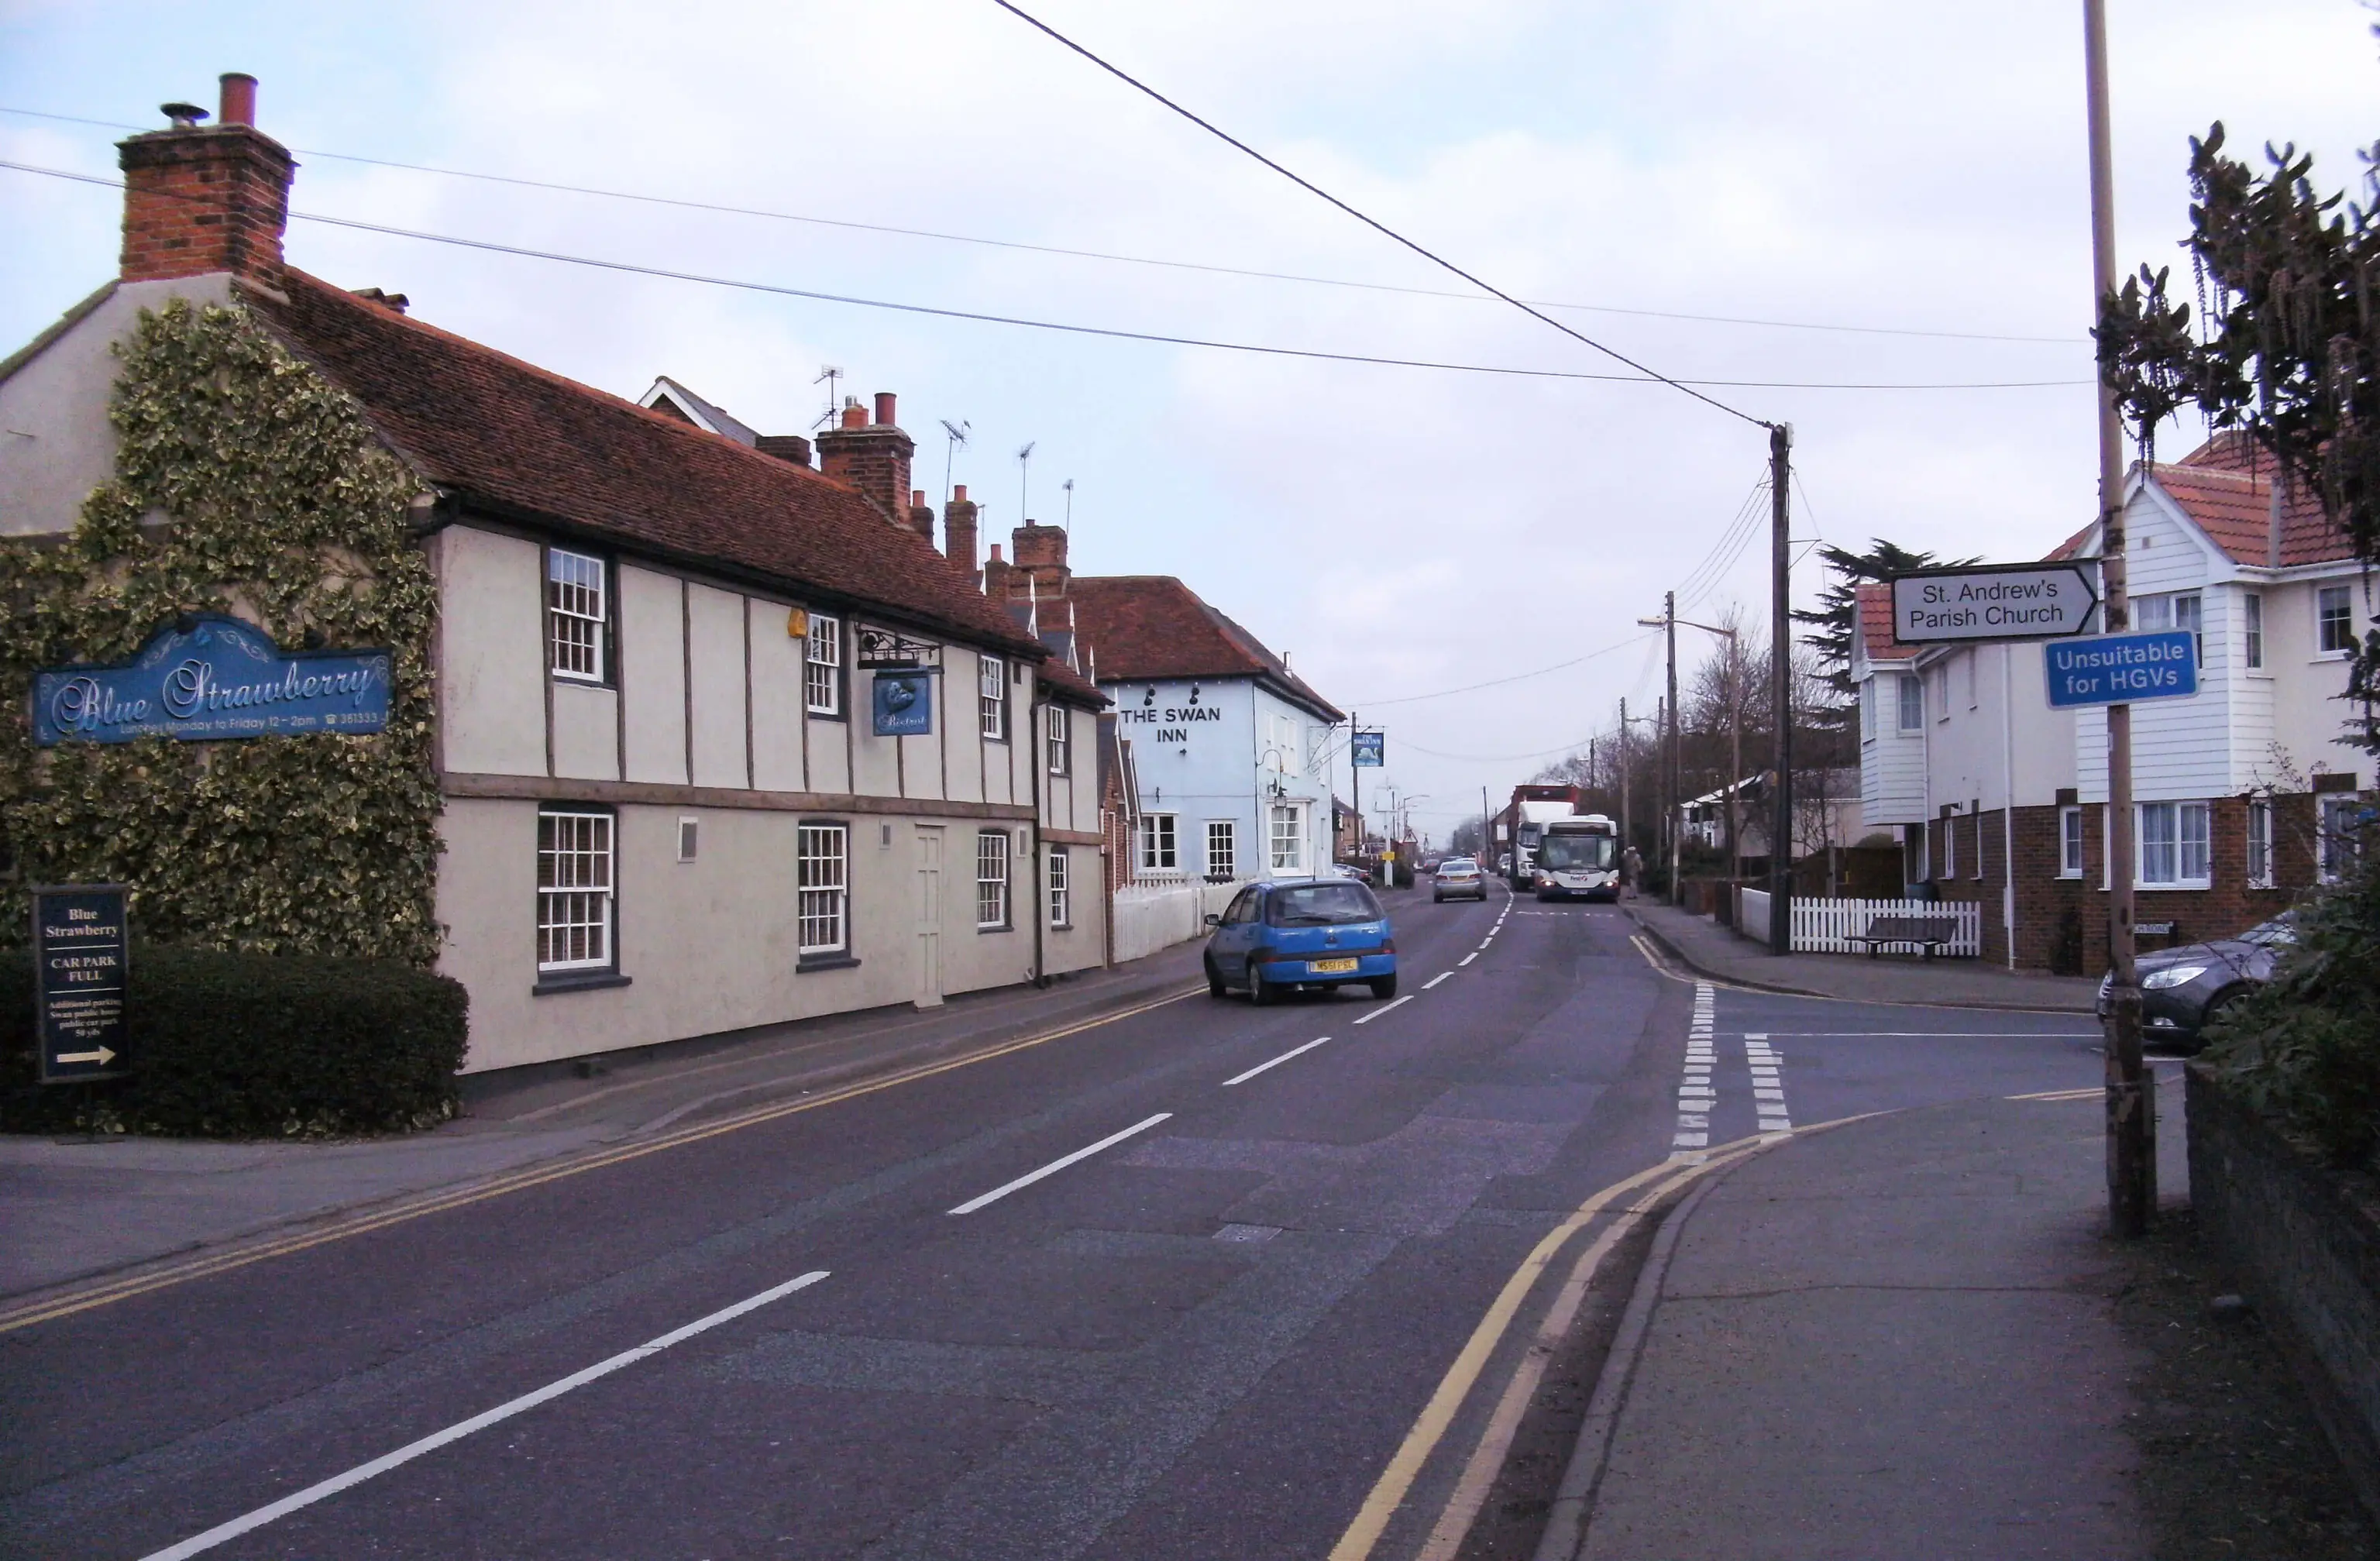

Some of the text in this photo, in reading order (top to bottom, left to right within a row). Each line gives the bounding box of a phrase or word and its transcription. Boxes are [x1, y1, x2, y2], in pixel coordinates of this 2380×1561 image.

[1923, 579, 2058, 603] St. Andrew's
[1911, 603, 2063, 628] Parish Church
[2056, 641, 2185, 670] Unsuitable
[2065, 667, 2178, 694] for HGVs
[51, 658, 373, 734] Blue Strawberry
[215, 719, 226, 730] to
[229, 717, 265, 730] Friday
[1121, 707, 1221, 724] THE SWAN
[1157, 728, 1188, 743] INN
[69, 909, 98, 921] Blue
[46, 925, 118, 938] Strawberry
[51, 956, 117, 968] CAR PARK
[69, 971, 103, 982] FULL
